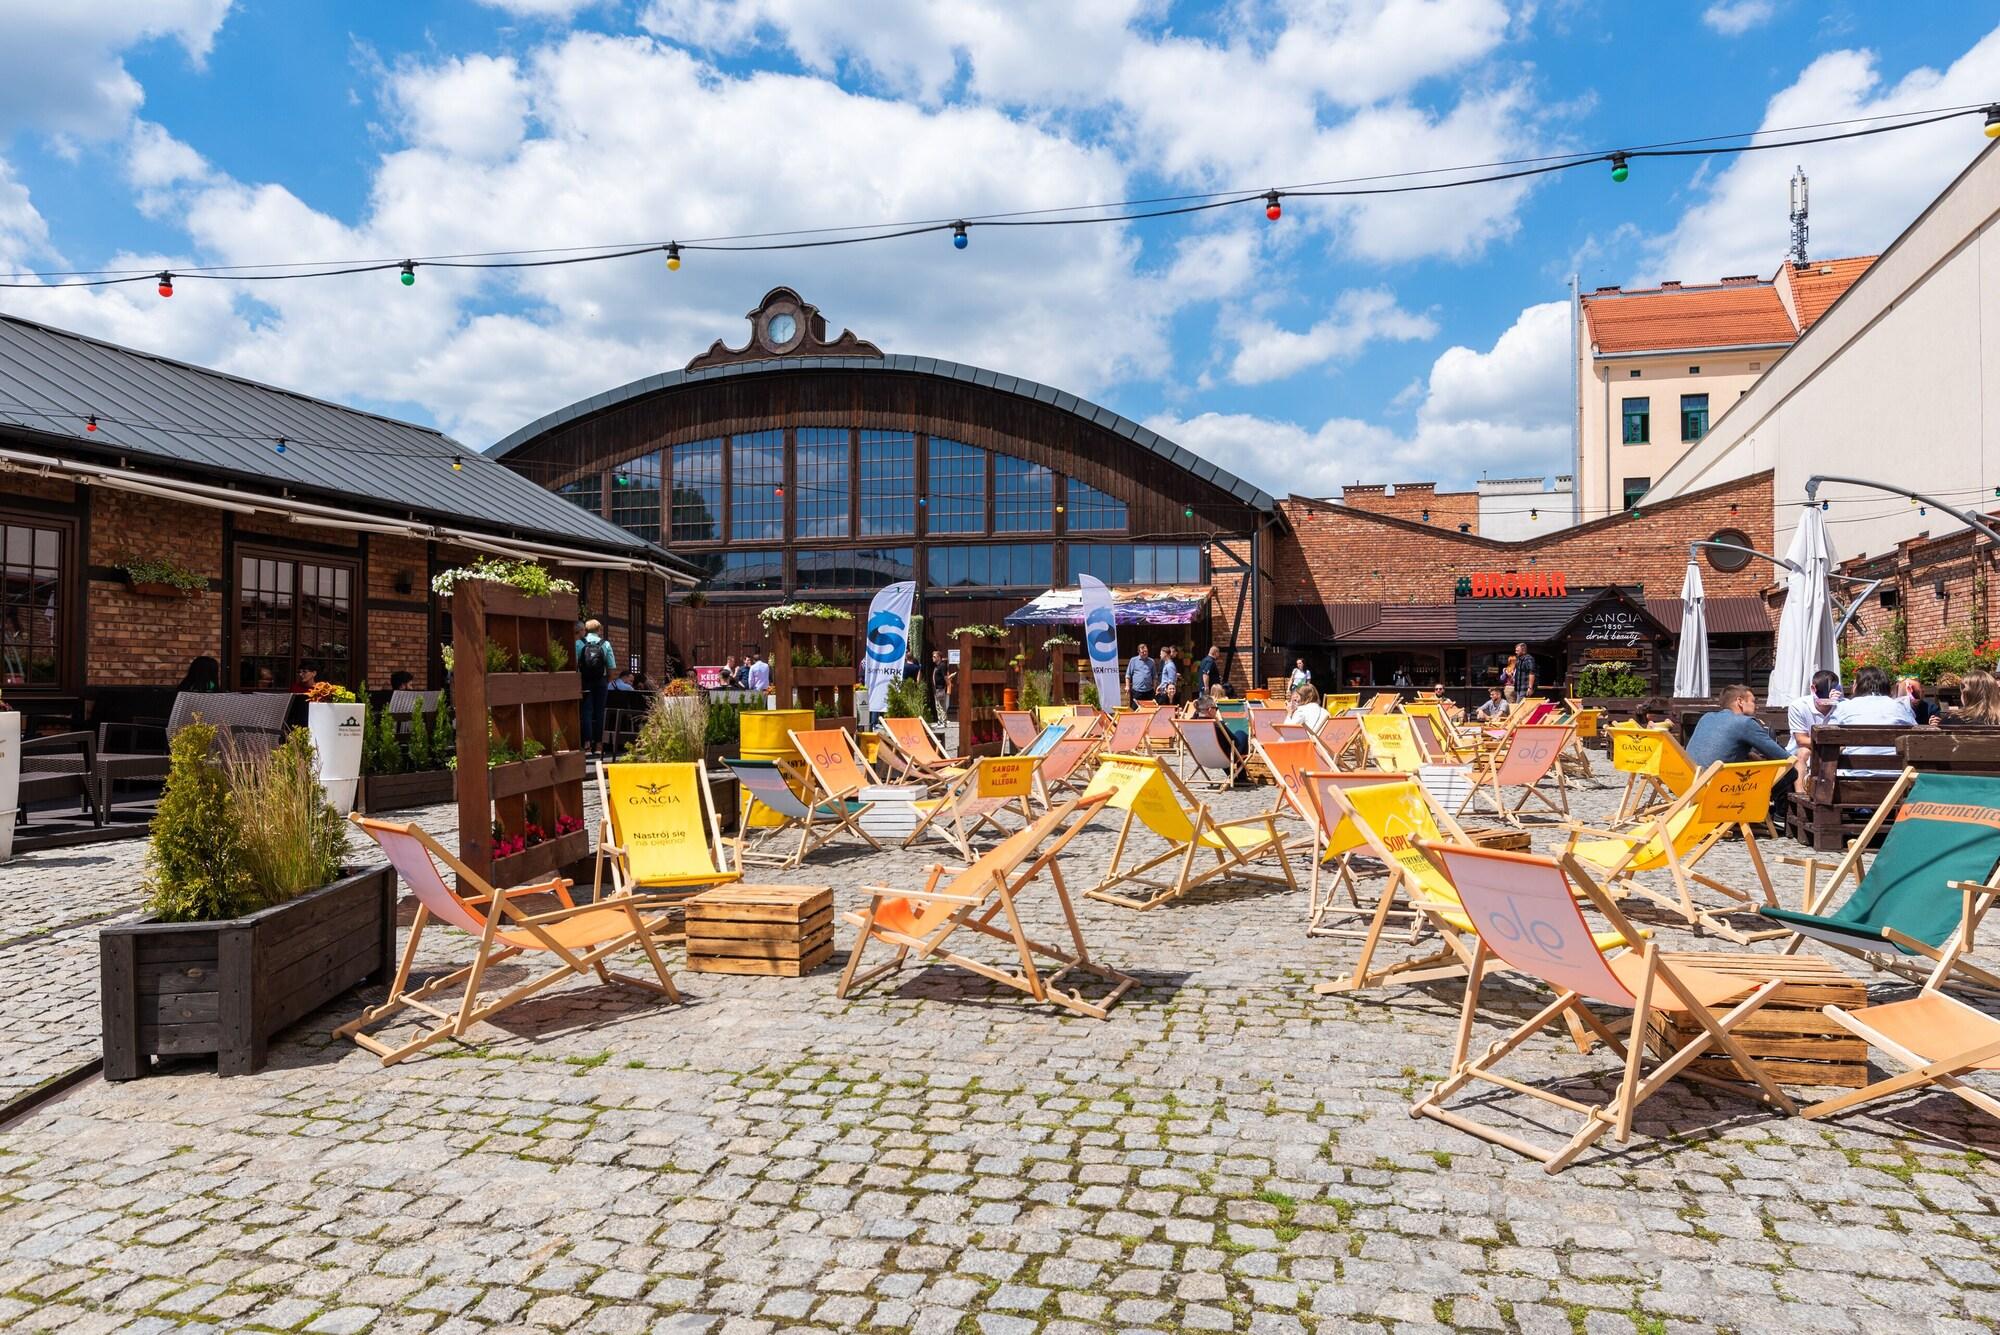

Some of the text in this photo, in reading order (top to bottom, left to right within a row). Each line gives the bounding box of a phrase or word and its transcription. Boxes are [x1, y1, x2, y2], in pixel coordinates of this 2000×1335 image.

[1457, 572, 1567, 597] #BROWAR
[1583, 612, 1643, 623] GANCIA
[1585, 630, 1640, 647] drink beauty
[1622, 743, 1653, 753] GANCIA
[816, 746, 842, 769] glo
[1720, 782, 1758, 793] GANCIA
[629, 795, 681, 805] GANCIA
[633, 831, 670, 840] Nastrój
